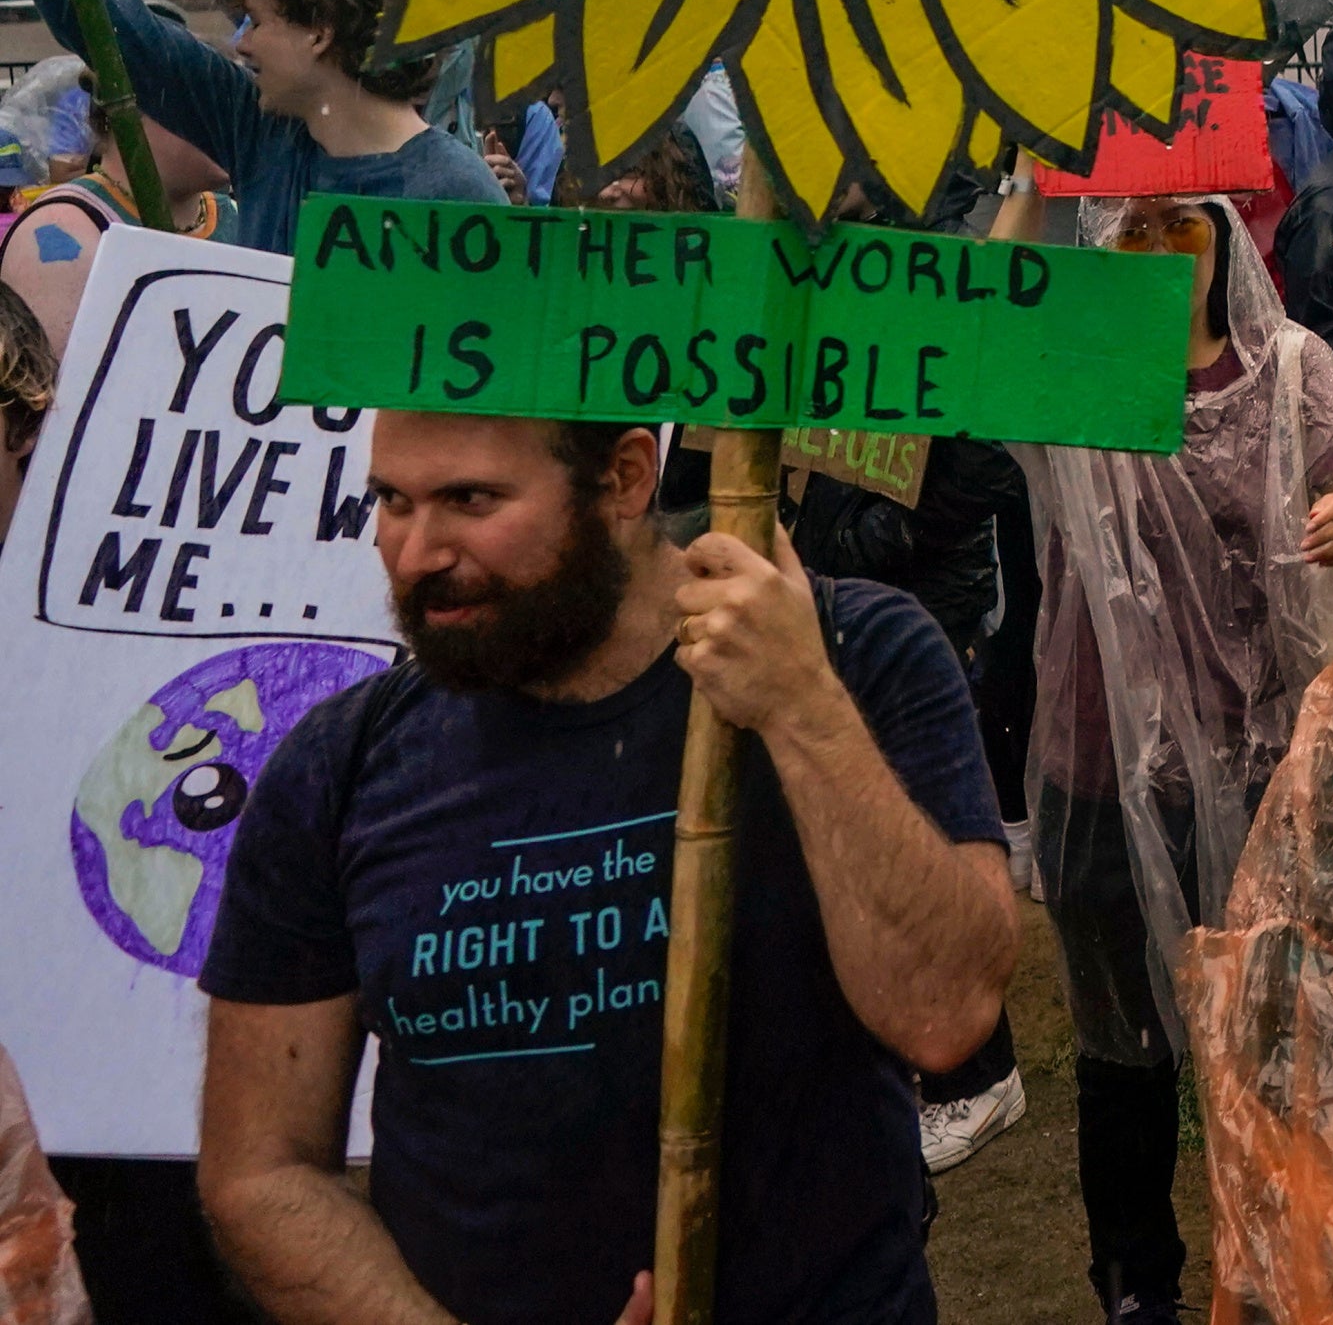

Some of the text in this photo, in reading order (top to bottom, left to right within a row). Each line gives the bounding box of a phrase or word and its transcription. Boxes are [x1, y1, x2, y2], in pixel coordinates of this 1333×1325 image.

[316, 205, 1051, 307] ANOTHER WORLD
[172, 308, 361, 432] YO
[409, 321, 948, 419] IS POSSIBLE
[112, 419, 300, 537] LIVE
[440, 839, 656, 916] you have the
[412, 897, 670, 977] RIGHT TO A
[388, 980, 549, 1034] healthy
